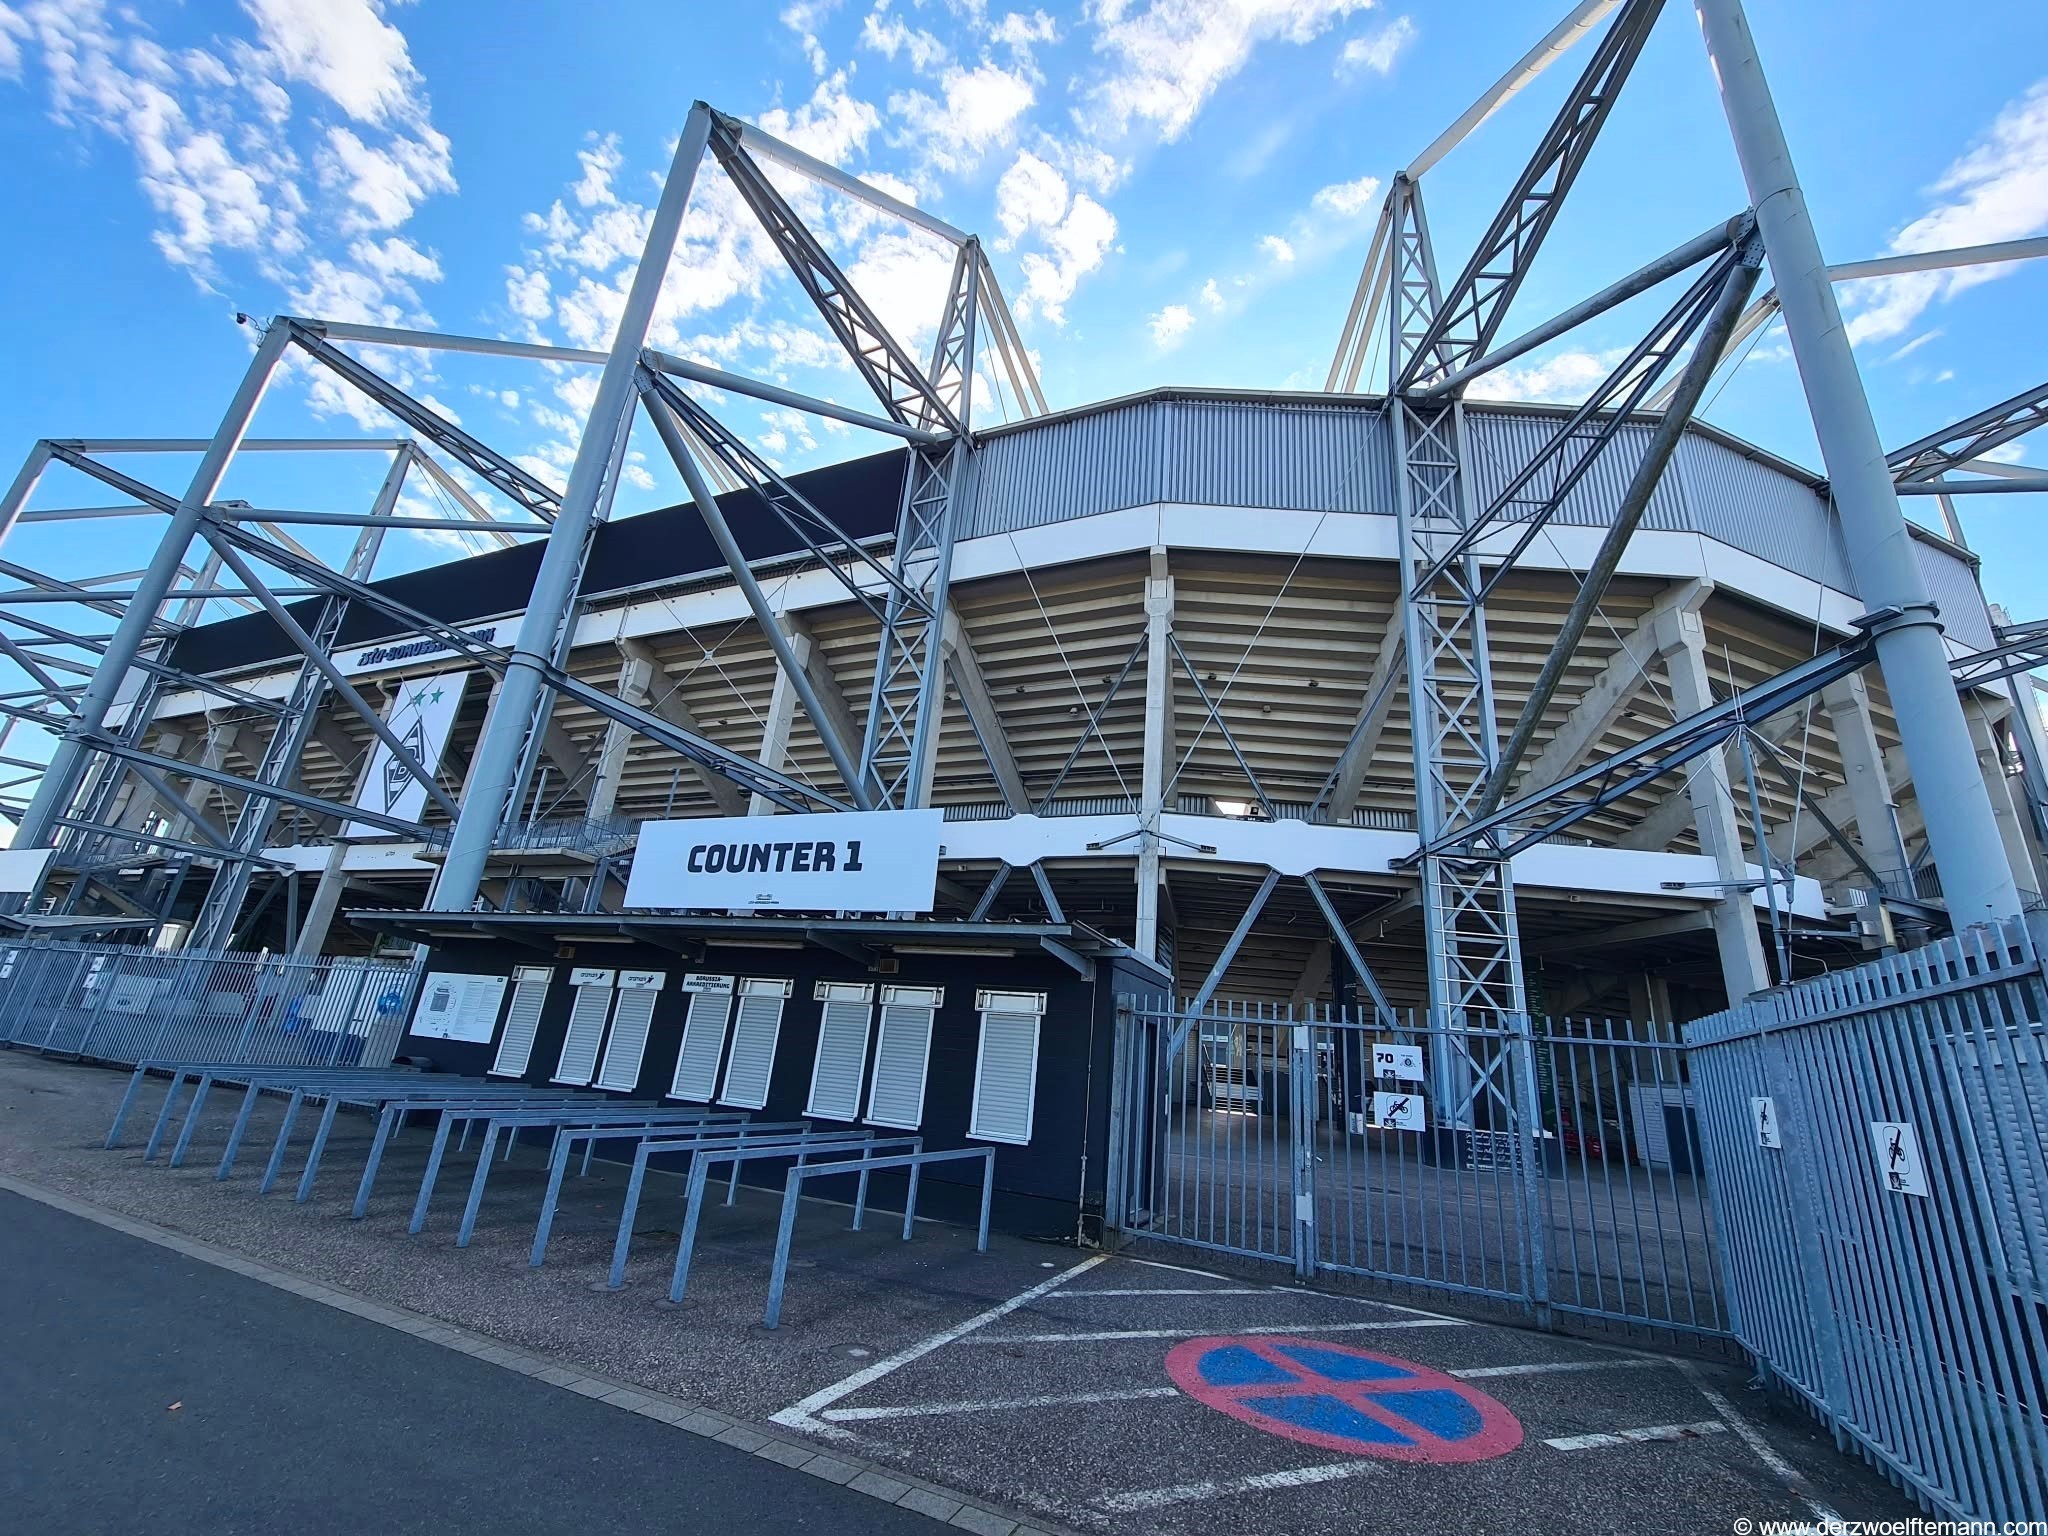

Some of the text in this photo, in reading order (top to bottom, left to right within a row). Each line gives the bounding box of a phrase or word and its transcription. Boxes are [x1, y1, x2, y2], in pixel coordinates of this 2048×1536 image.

[687, 841, 862, 873] COUNTER 1
[1376, 1052, 1394, 1064] 70
